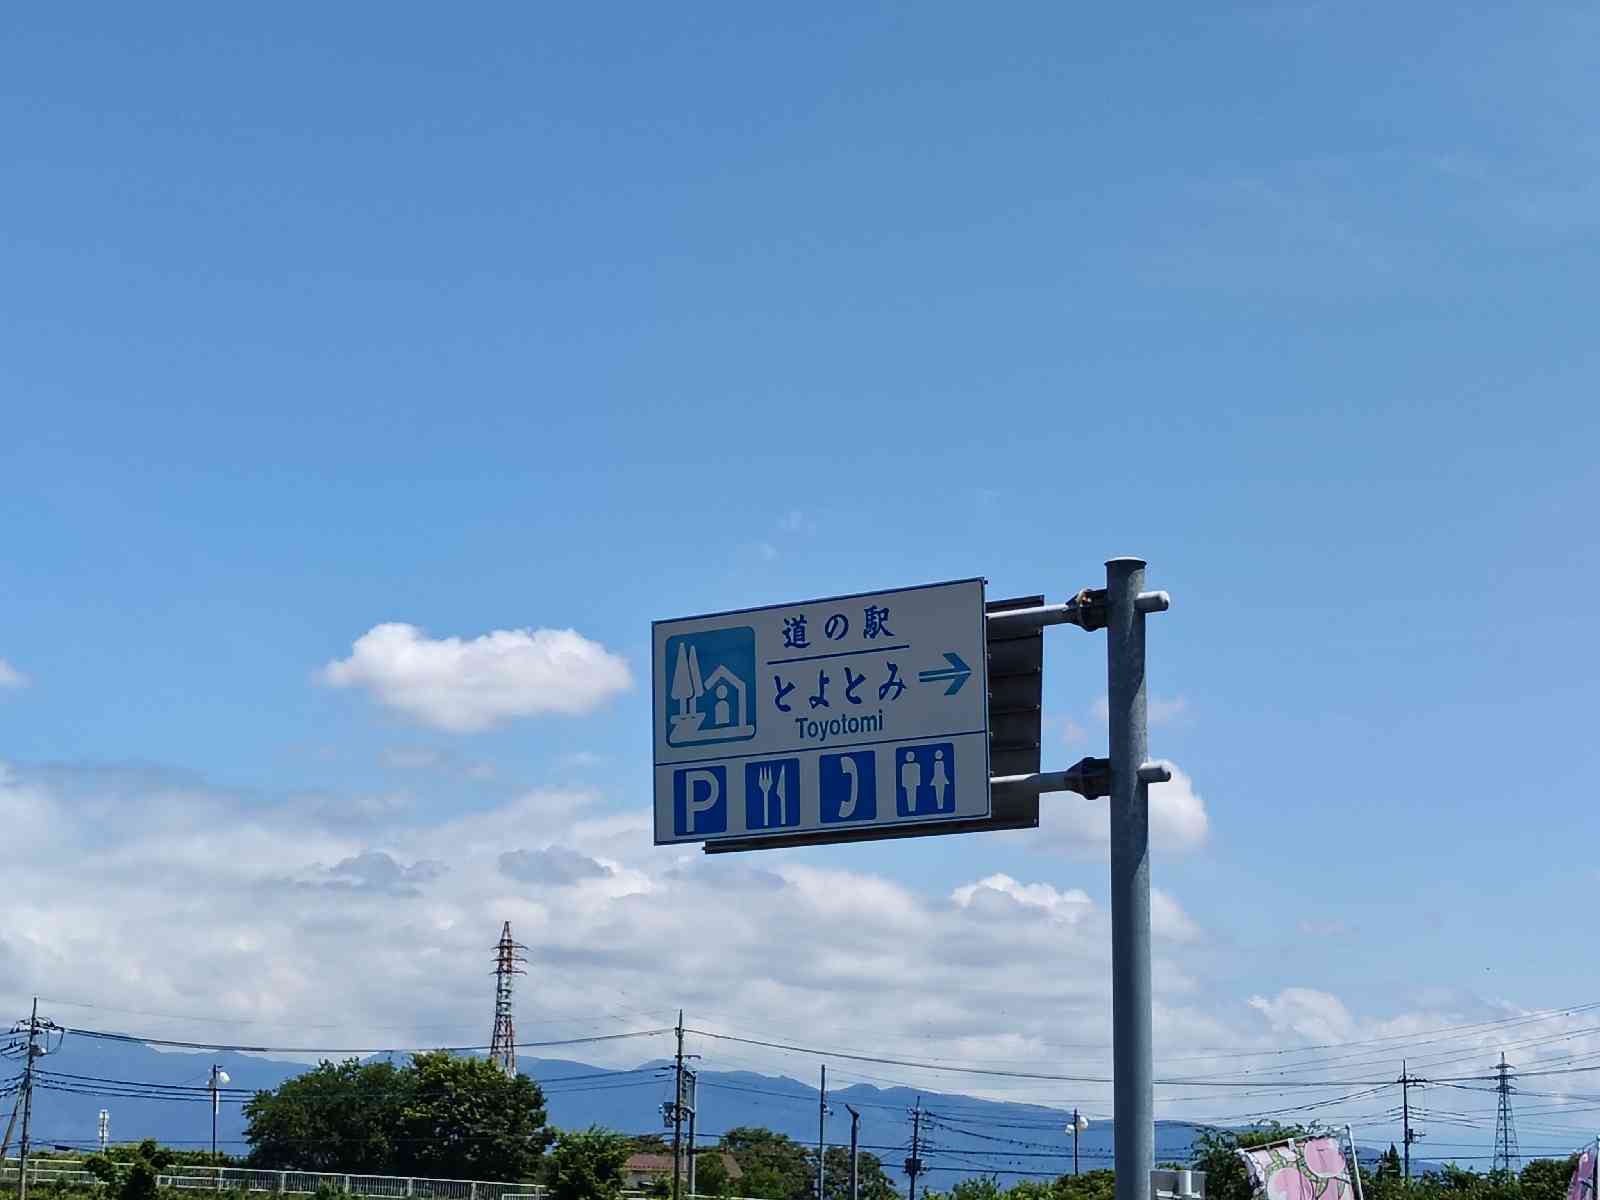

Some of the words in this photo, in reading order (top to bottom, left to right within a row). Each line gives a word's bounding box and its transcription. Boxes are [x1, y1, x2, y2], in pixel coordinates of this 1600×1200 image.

[782, 605, 895, 649] 道の駅
[774, 661, 907, 712] とよとみ
[795, 710, 884, 742] Toyotomi
[686, 770, 720, 833] P
